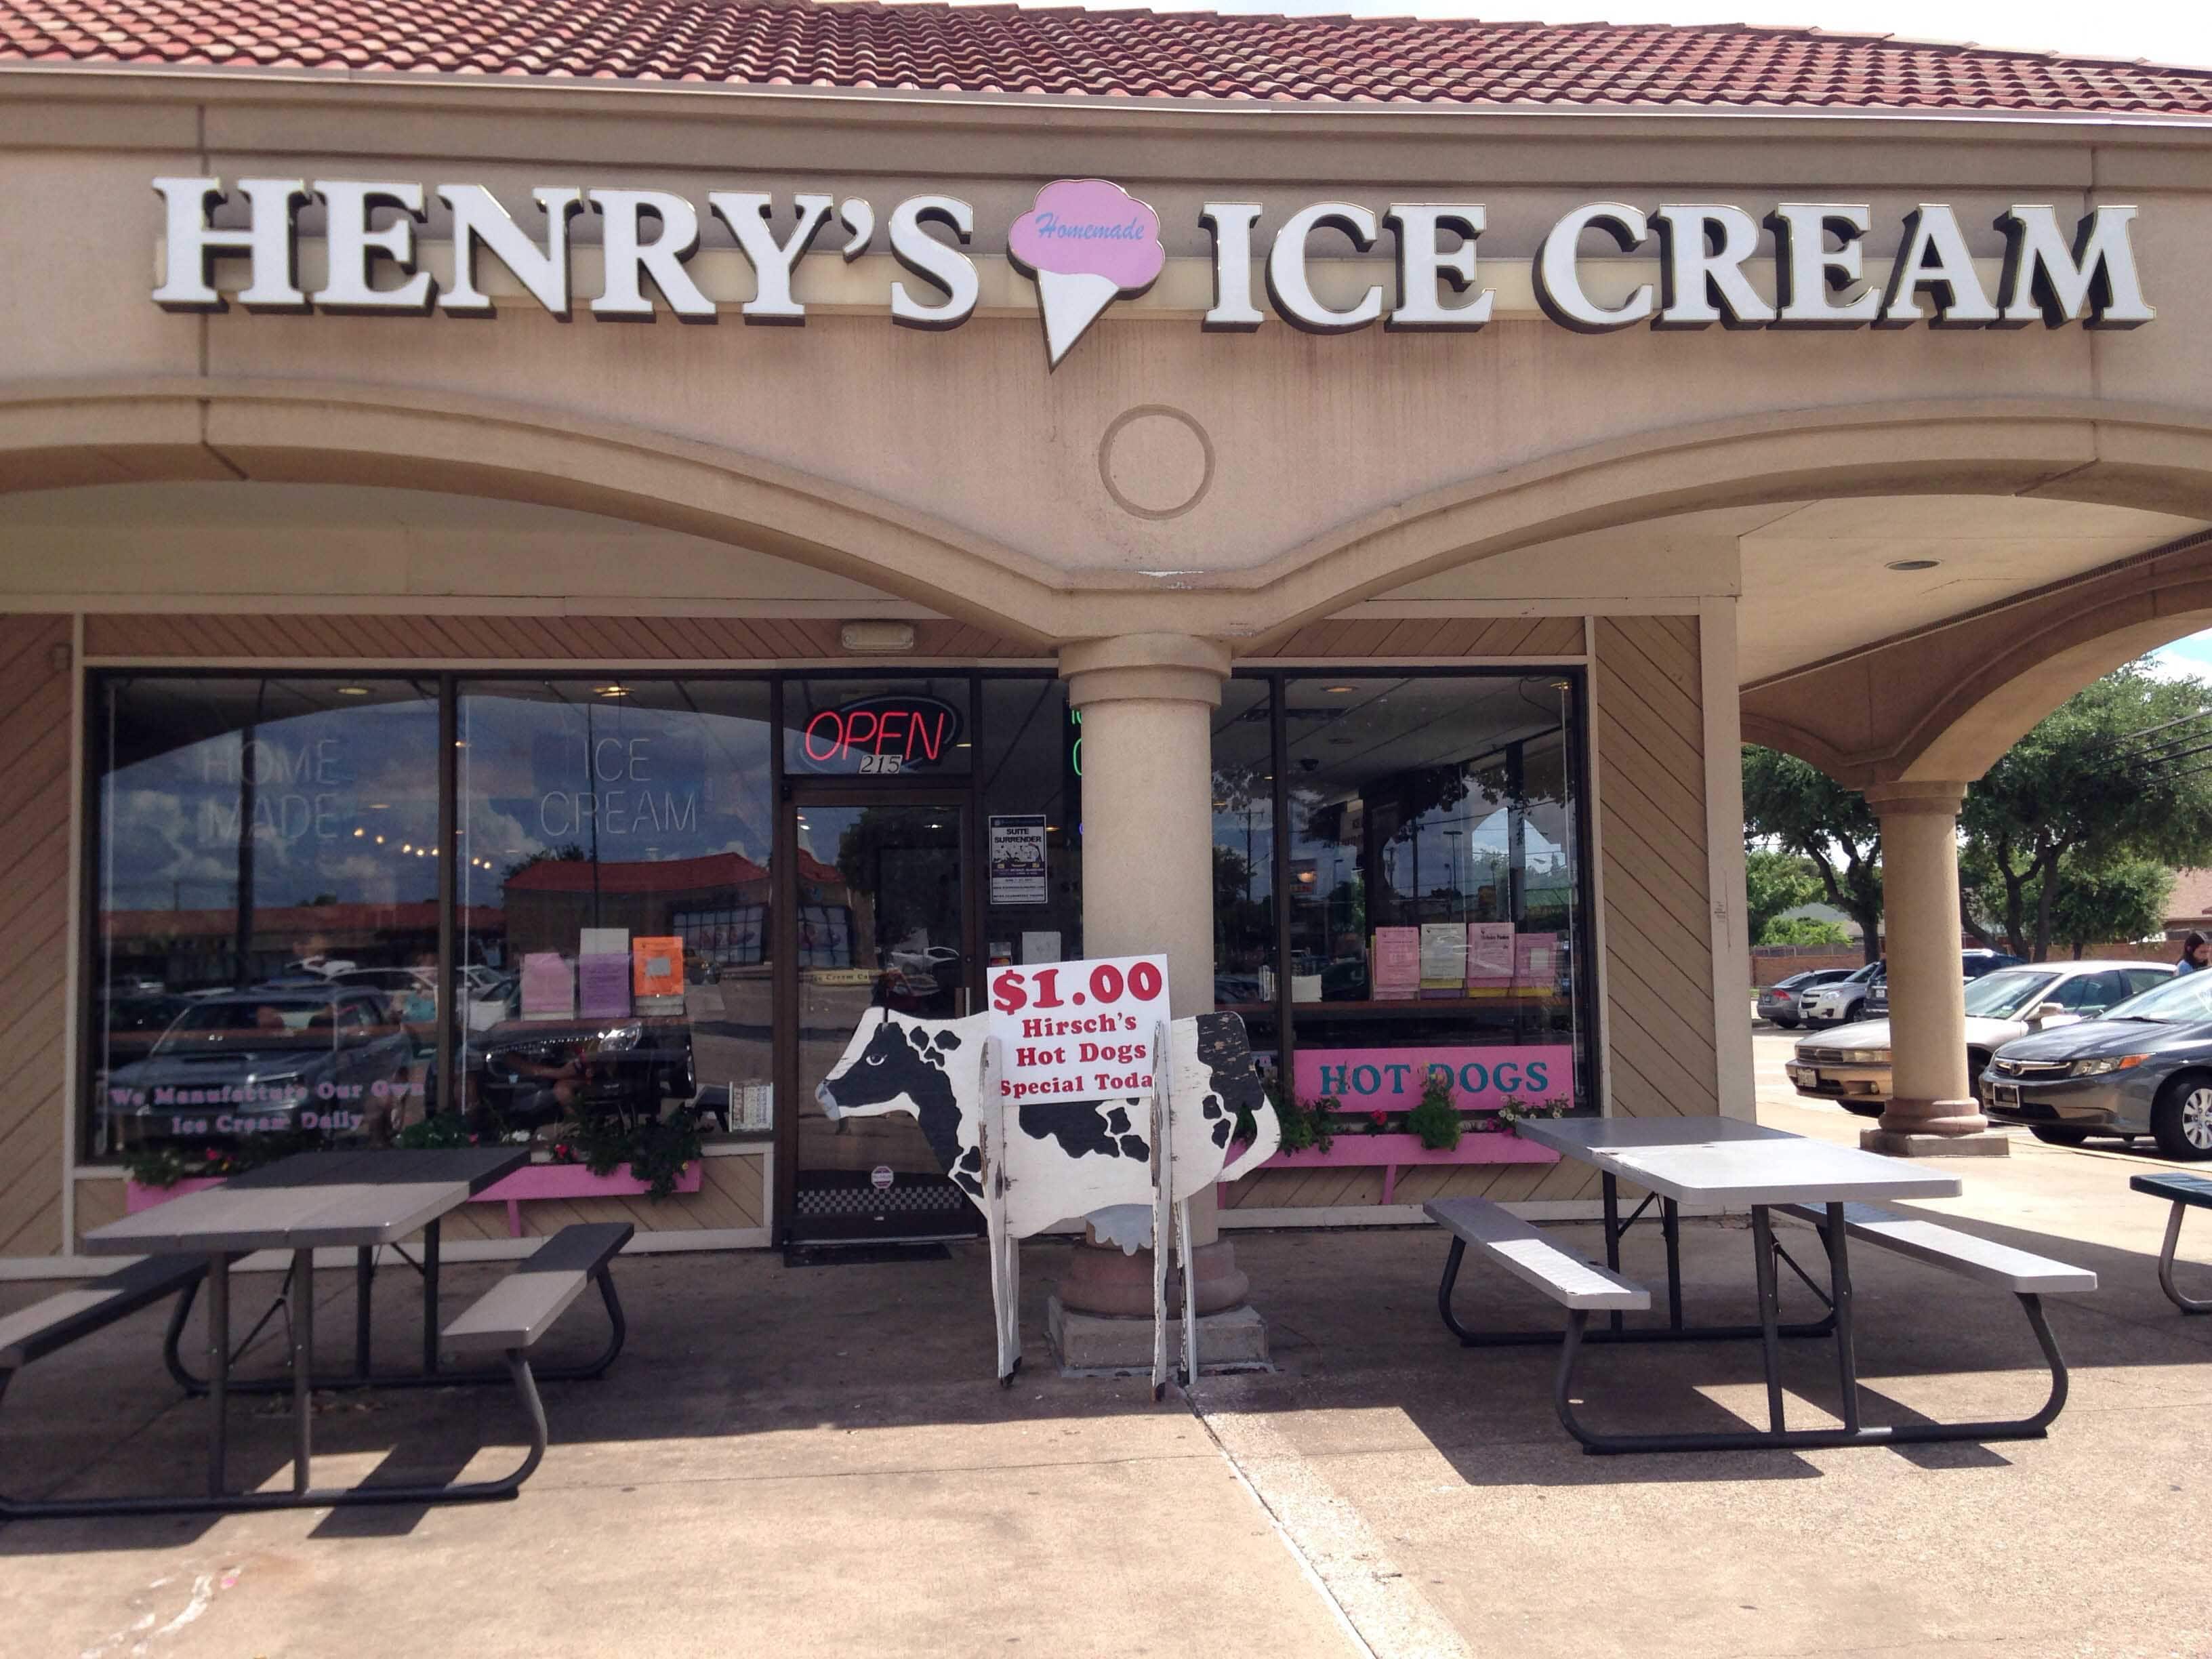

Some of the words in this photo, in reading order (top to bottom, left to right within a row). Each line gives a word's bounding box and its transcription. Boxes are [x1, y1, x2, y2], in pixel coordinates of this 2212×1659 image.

[1034, 211, 1145, 241] Homemade
[152, 177, 979, 329] HENRY'S
[1198, 201, 1498, 334] ICE
[1534, 201, 2157, 333] CREAM
[804, 711, 945, 762] OPEN
[204, 739, 339, 785] HOME
[583, 737, 651, 782] ICE
[861, 755, 903, 773] 215
[198, 793, 339, 842] MADE
[540, 790, 697, 837] CREAM
[994, 836, 1042, 844] SURRENDER
[992, 961, 1163, 1017] $1.00
[1021, 1012, 1137, 1038] Hirsch's
[1016, 1047, 1066, 1067] Hot
[1079, 1042, 1147, 1065] Dogs
[108, 1087, 146, 1107] We
[153, 1084, 310, 1106] Manufacture
[315, 1081, 364, 1100] Our
[370, 1080, 426, 1097] Own
[1000, 1075, 1085, 1099] Special
[1094, 1071, 1153, 1091] Toda
[1319, 1063, 1412, 1096] HOT
[1427, 1061, 1549, 1094] DOGS
[170, 1115, 208, 1135] Ice
[216, 1115, 292, 1133] Cream
[300, 1111, 365, 1130] Daily
